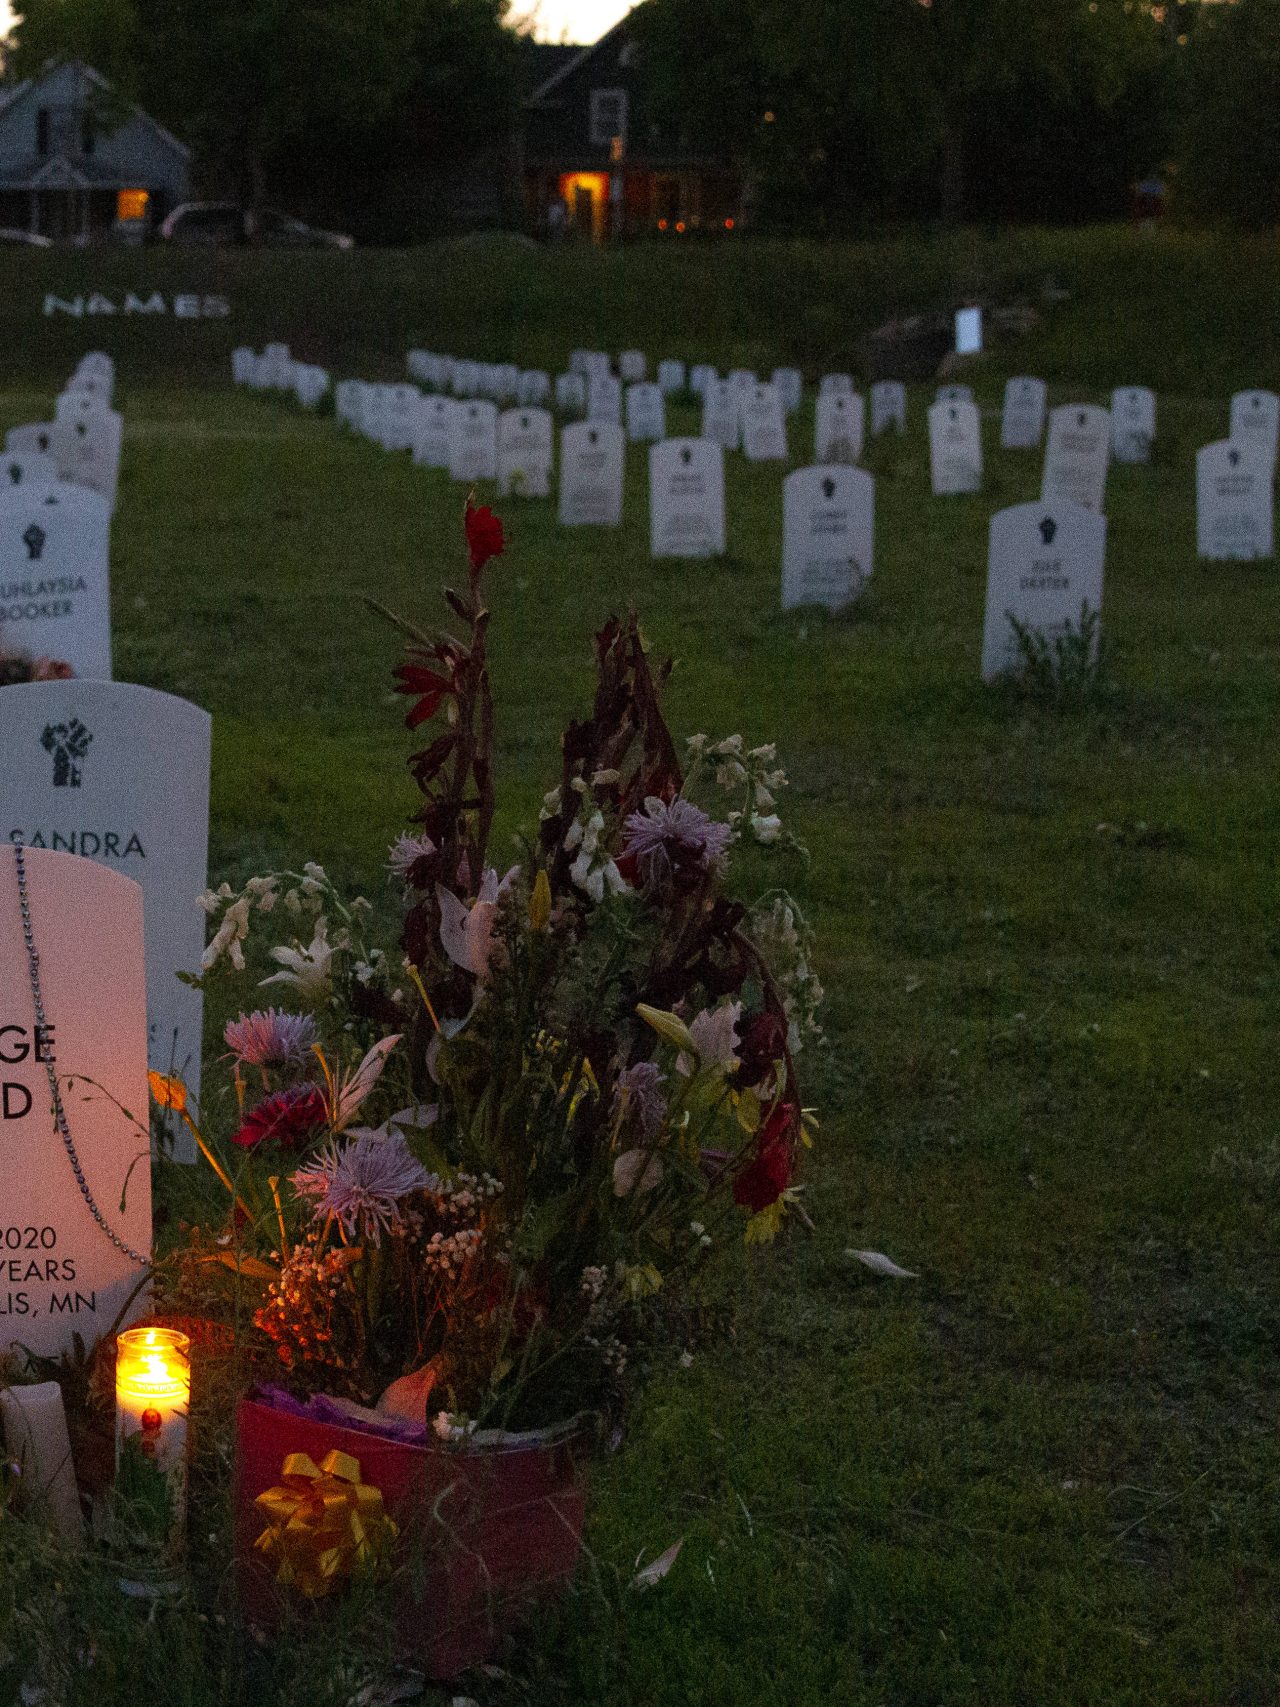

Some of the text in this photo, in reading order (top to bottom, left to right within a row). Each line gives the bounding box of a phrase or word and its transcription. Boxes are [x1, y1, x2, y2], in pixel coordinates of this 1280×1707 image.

[42, 292, 232, 318] NAMES
[9, 829, 146, 858] SANDRA
[49, 1292, 96, 1313] MN
